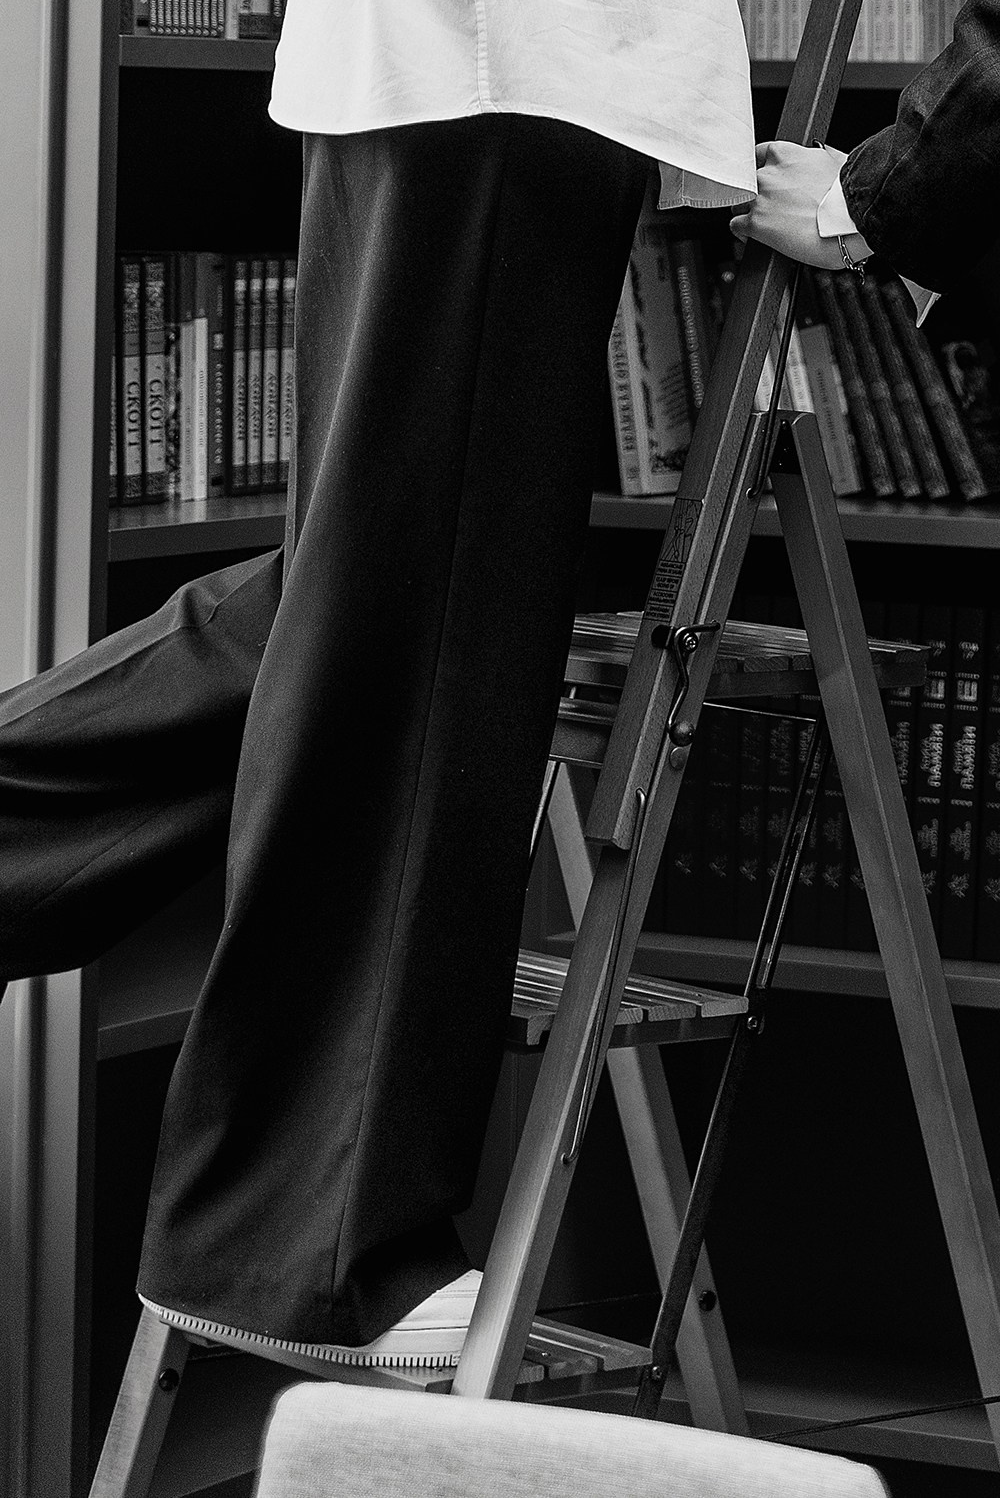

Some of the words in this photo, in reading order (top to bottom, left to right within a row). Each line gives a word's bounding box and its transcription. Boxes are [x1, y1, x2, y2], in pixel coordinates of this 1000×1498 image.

[125, 381, 141, 446] СКОТТ
[149, 379, 164, 443] СКОТТ
[927, 723, 944, 788] ПАМЯТИ
[960, 725, 977, 790] ПАМЯТИ
